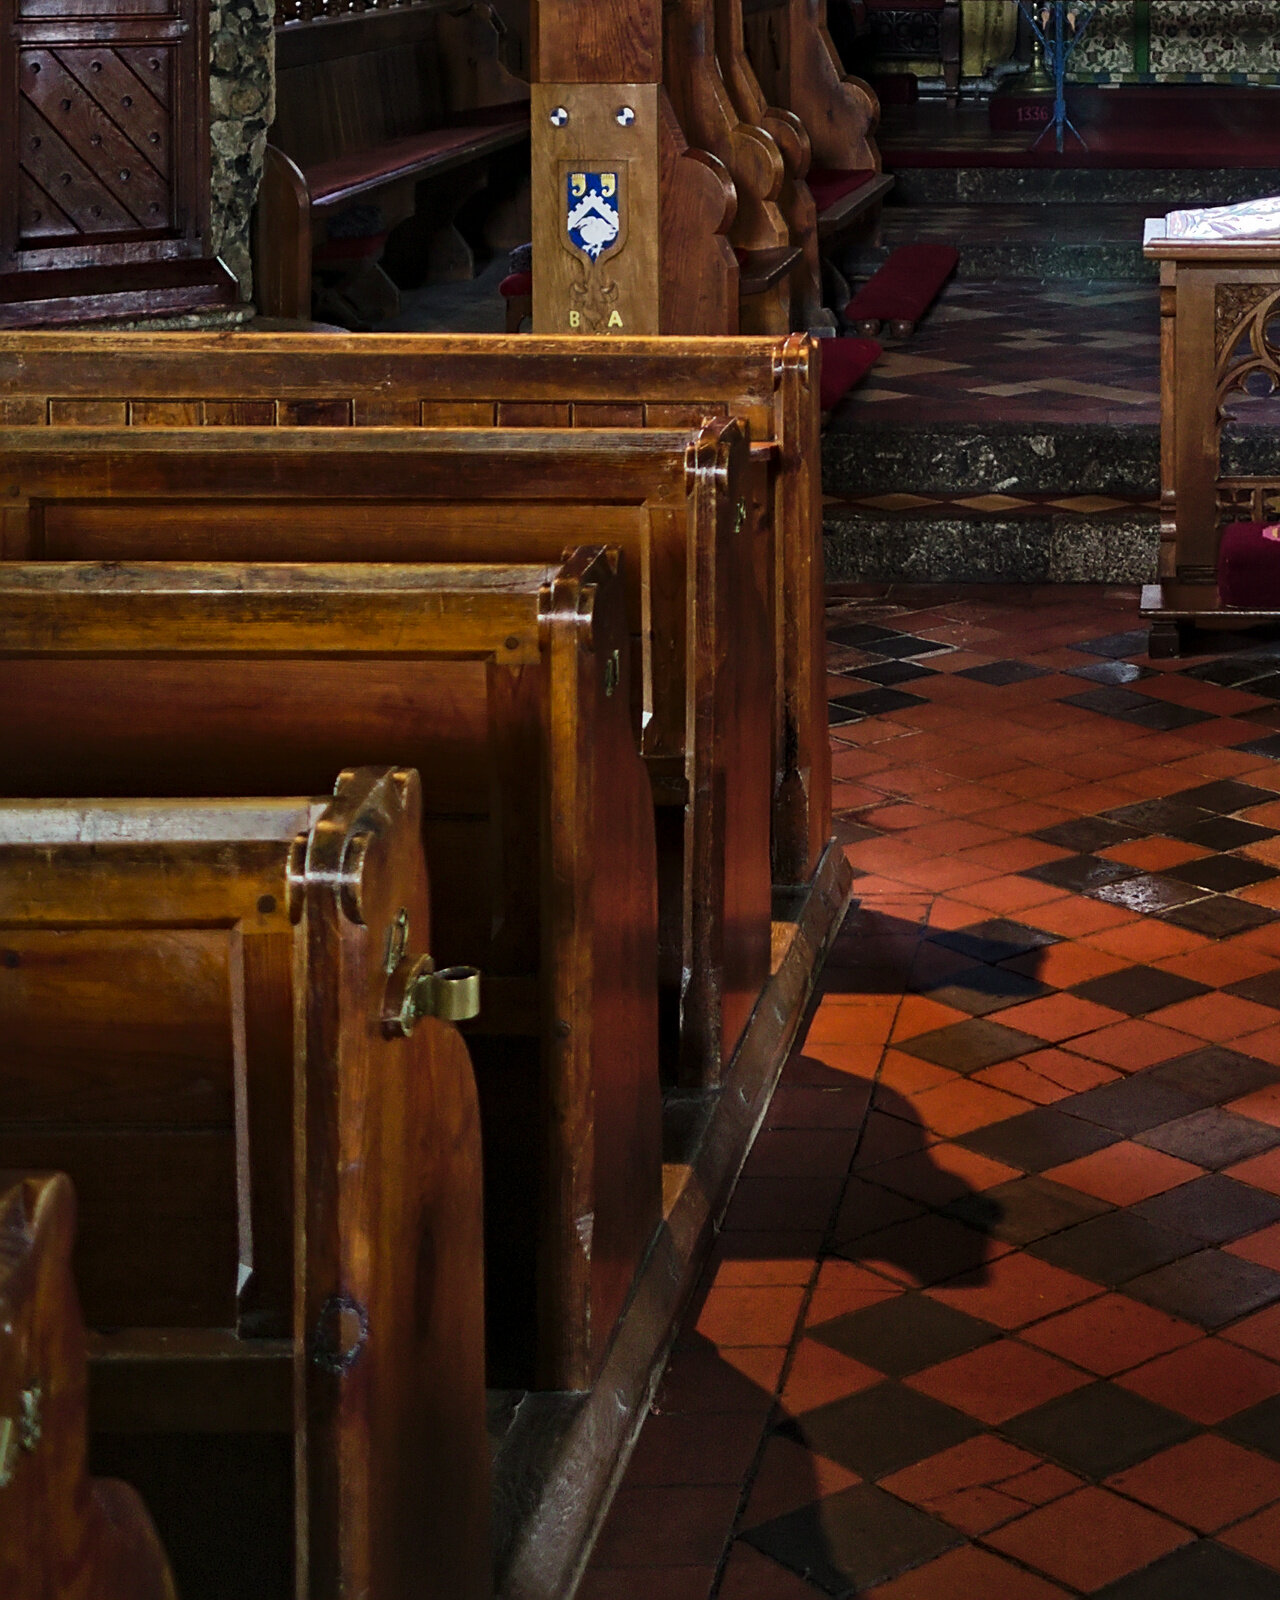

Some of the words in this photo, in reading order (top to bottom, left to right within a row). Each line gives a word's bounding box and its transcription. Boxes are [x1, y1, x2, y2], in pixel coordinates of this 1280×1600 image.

[1016, 105, 1049, 122] 1336
[569, 310, 580, 328] B
[607, 310, 624, 328] A
